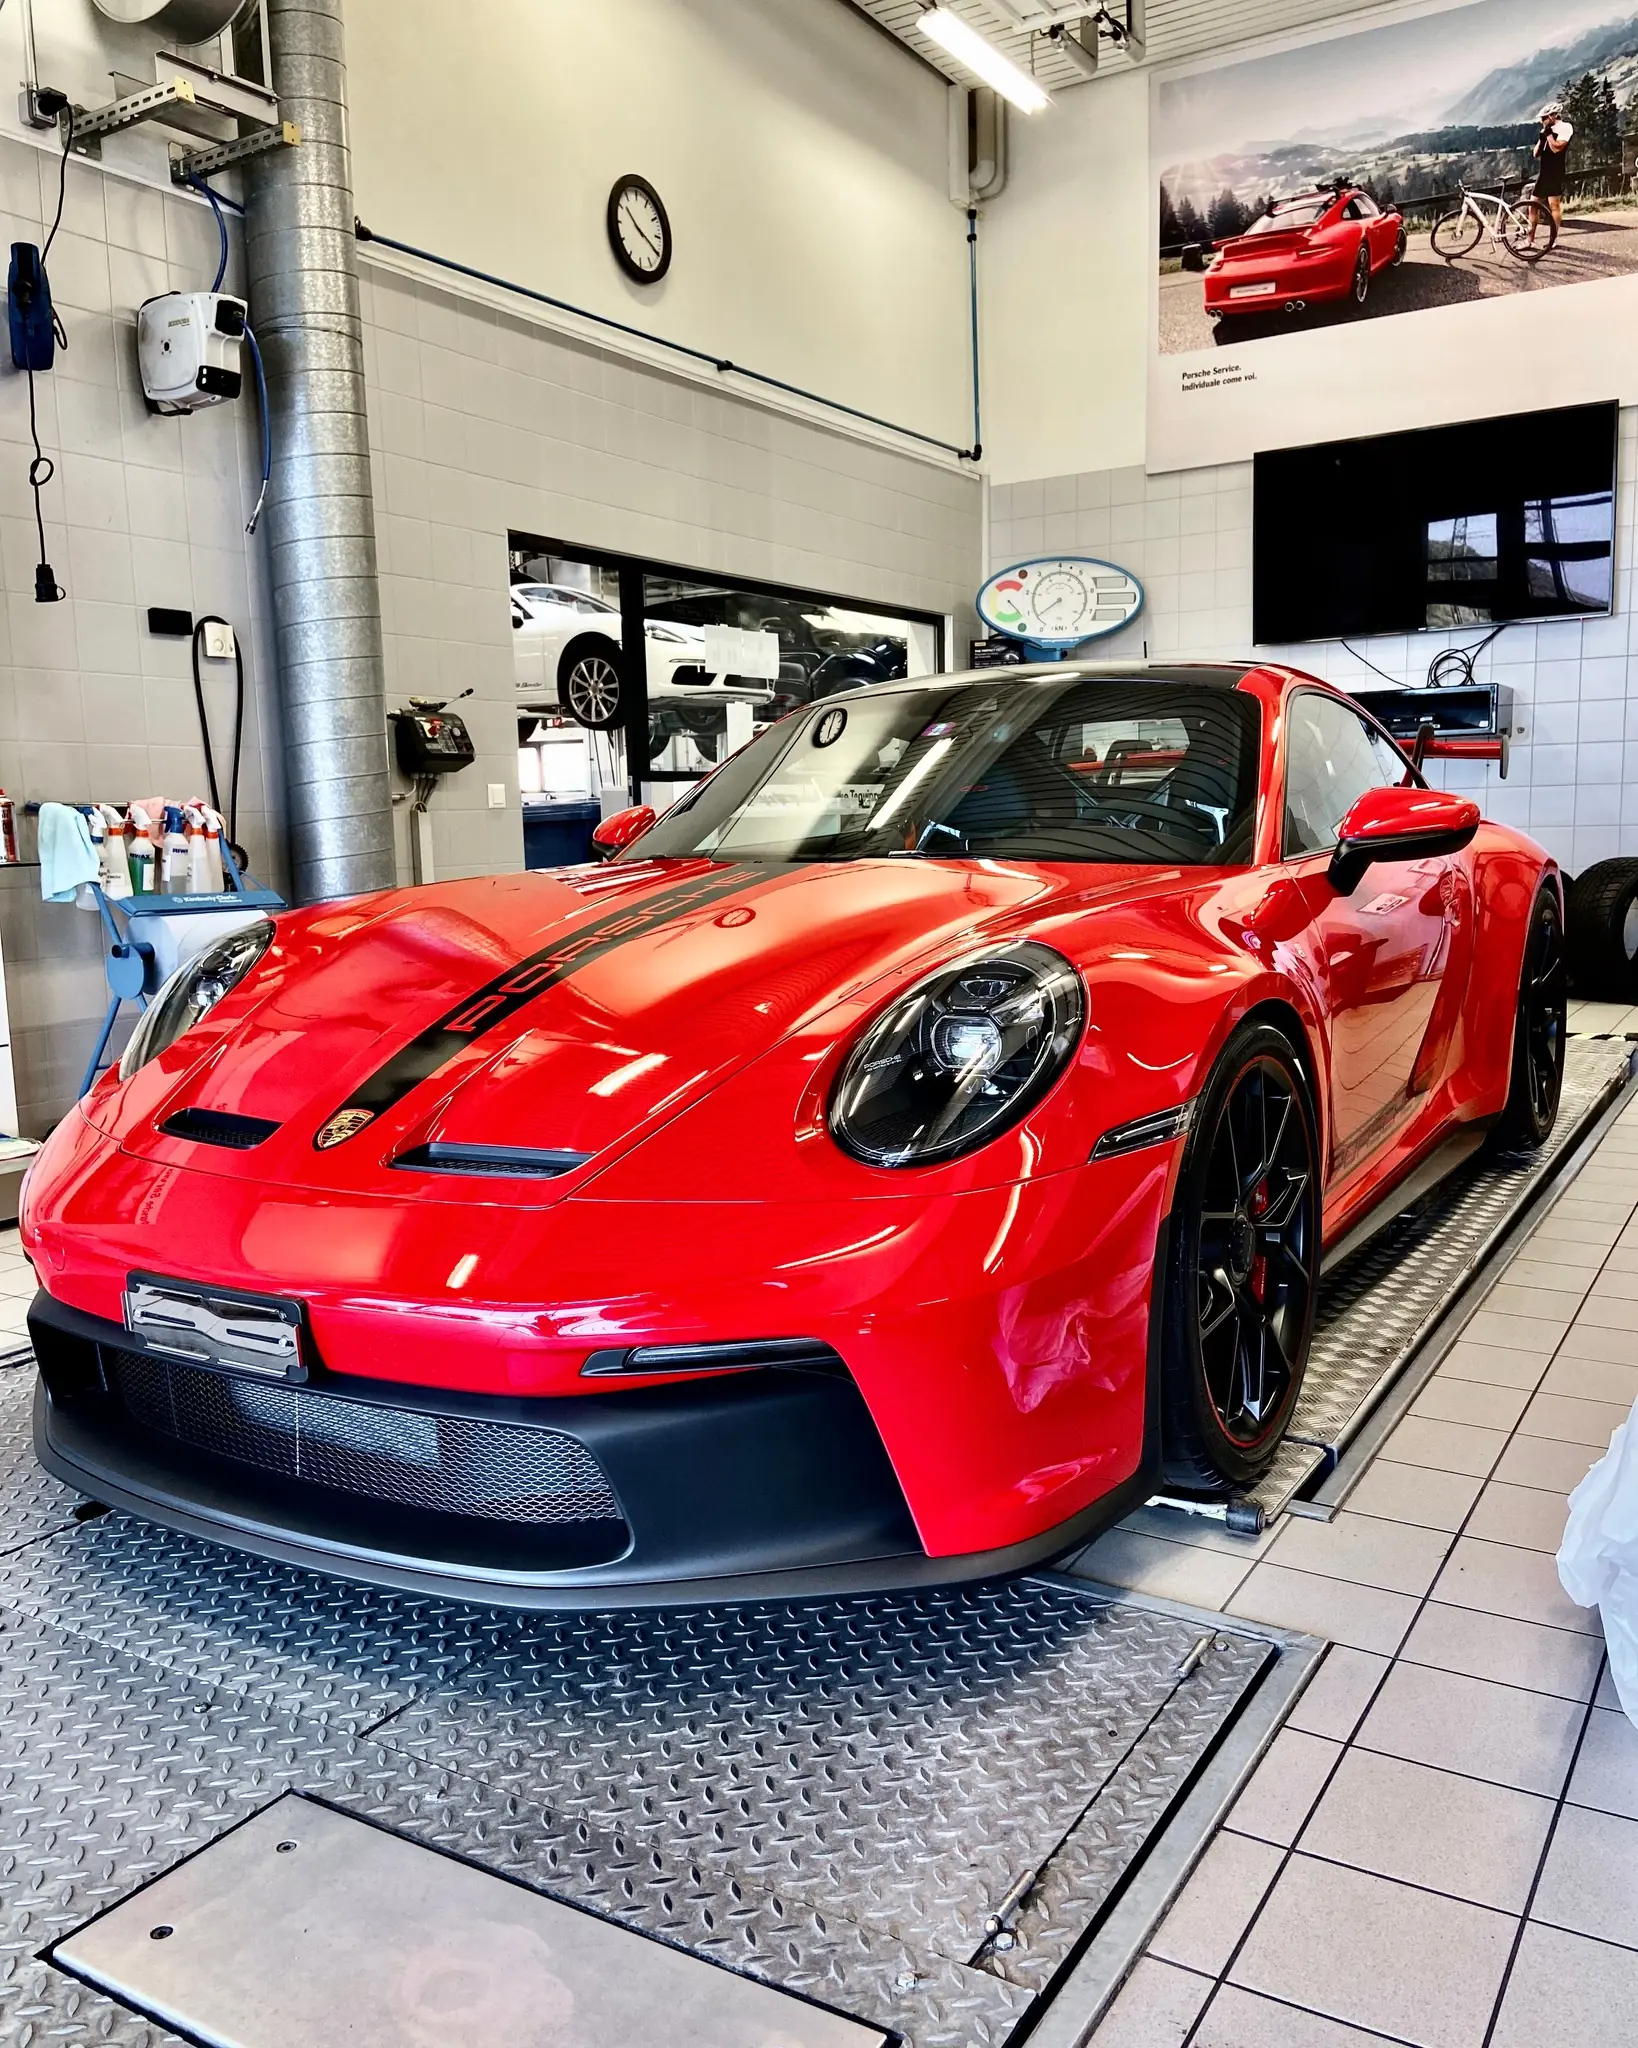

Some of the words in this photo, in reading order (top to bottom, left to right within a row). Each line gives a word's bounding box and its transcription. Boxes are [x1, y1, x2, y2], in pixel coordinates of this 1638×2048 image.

[1182, 369, 1211, 380] Porsche
[1213, 364, 1242, 375] Service.
[1182, 379, 1220, 391] Individuale
[1222, 376, 1242, 385] come
[1244, 372, 1257, 381] voi.
[444, 871, 767, 1032] PORSCHE
[863, 1054, 902, 1069] PORSCHE
